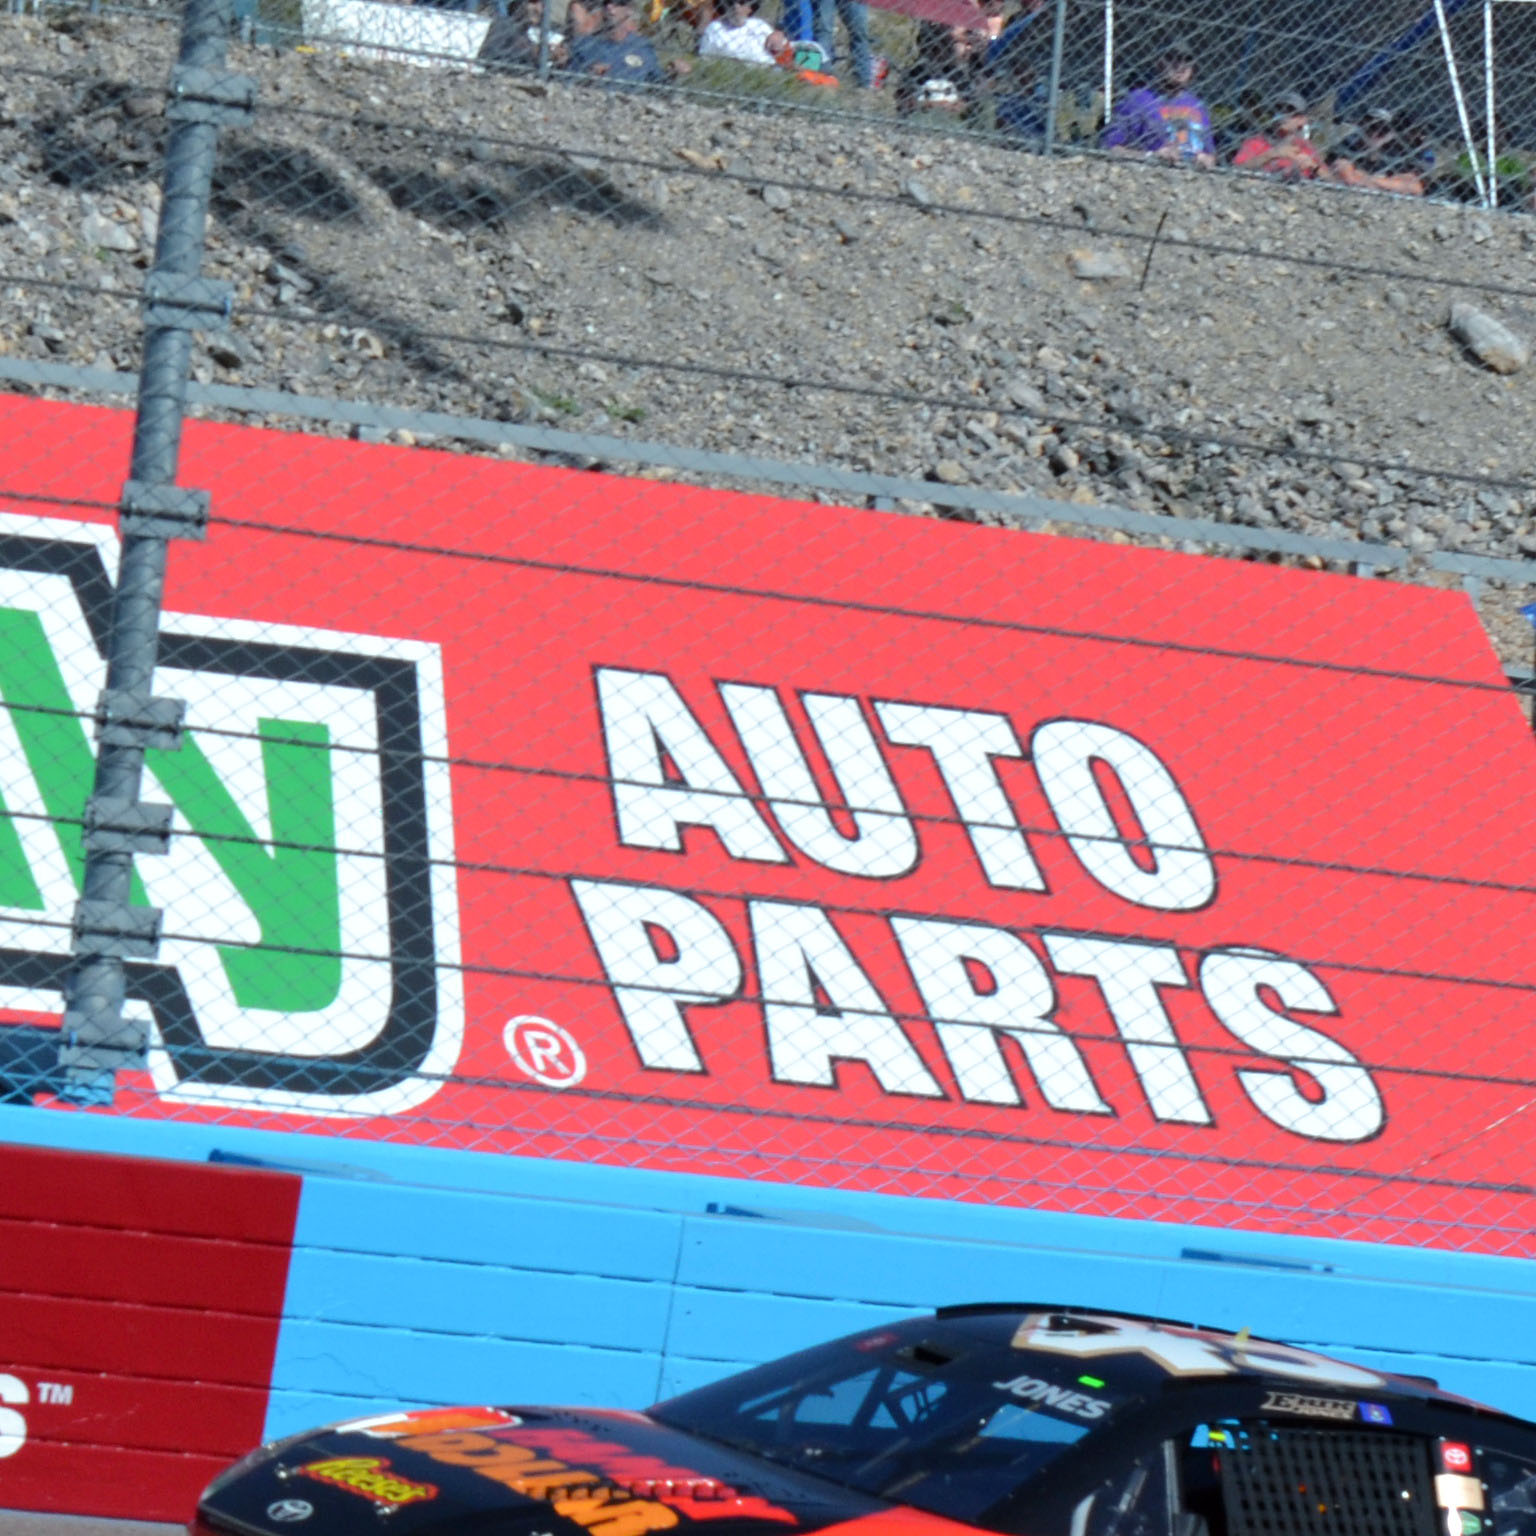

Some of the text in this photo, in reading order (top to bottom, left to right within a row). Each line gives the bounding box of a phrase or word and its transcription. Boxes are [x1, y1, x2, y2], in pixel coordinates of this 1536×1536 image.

[592, 664, 1219, 912] AUTO
[568, 875, 1388, 1143] PARTS
[993, 1375, 1113, 1420] JONES
